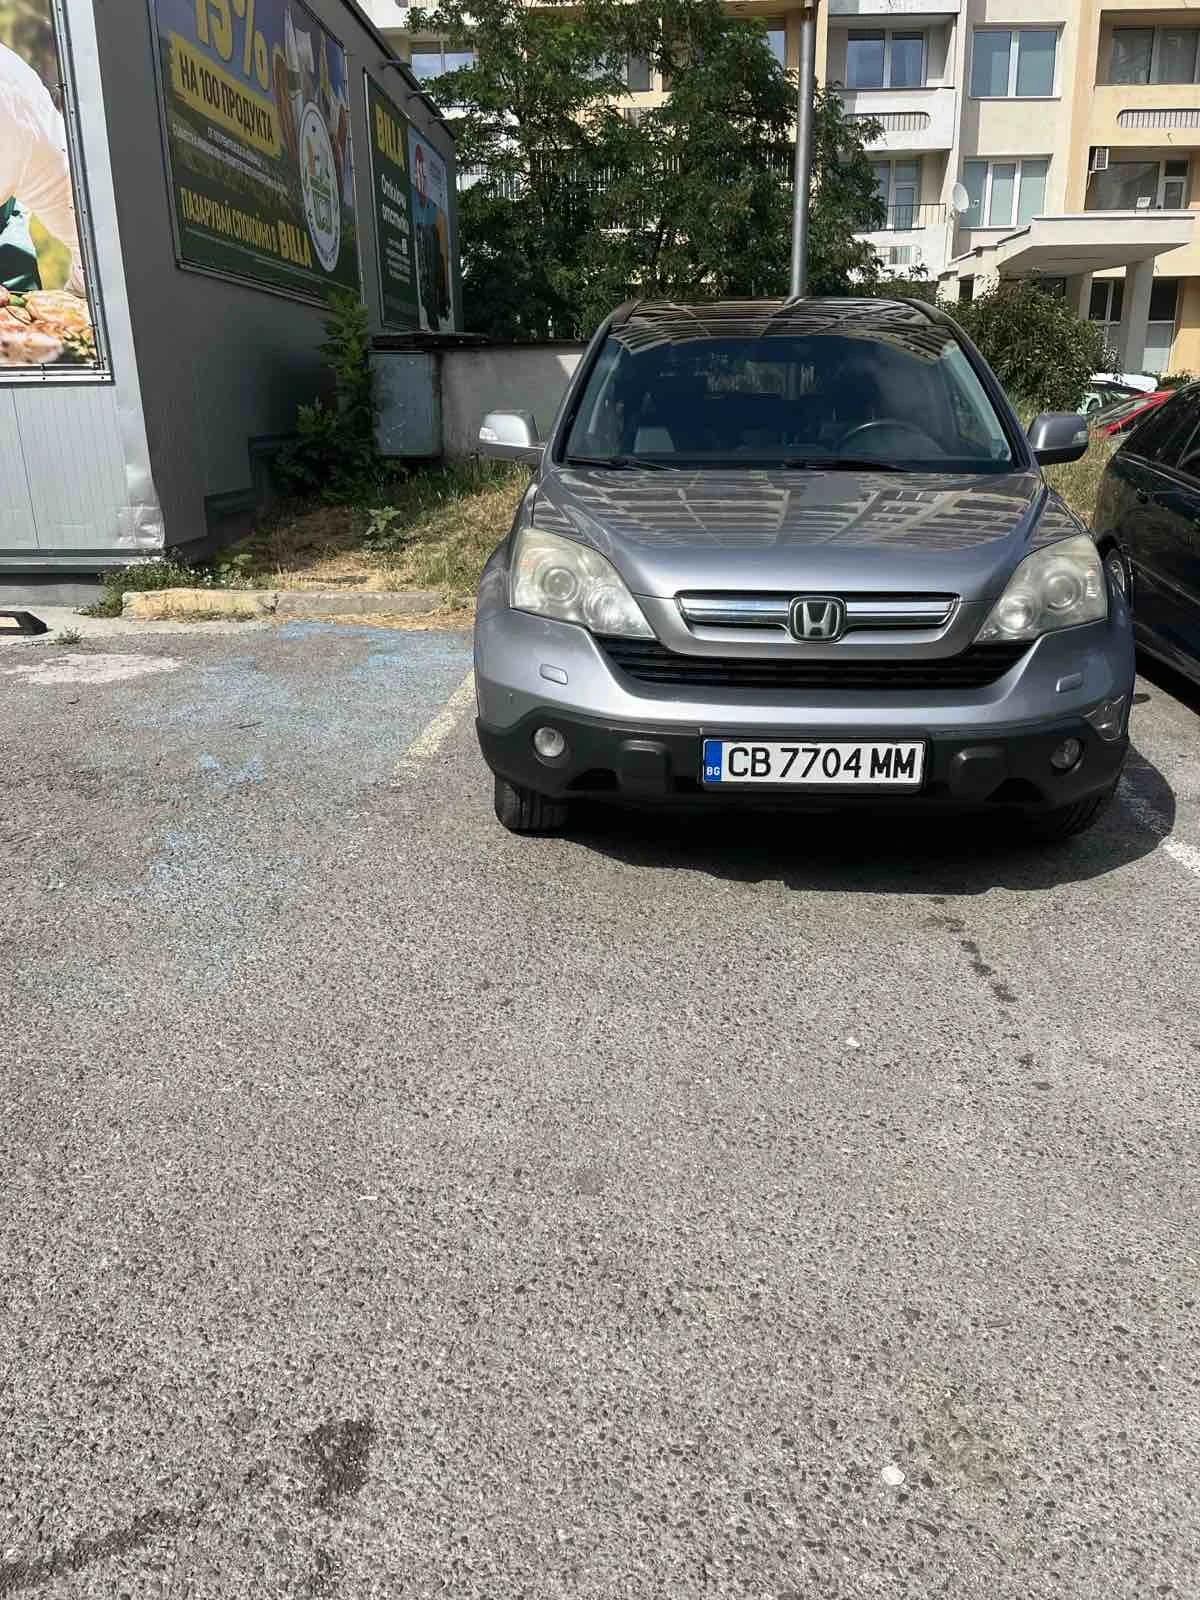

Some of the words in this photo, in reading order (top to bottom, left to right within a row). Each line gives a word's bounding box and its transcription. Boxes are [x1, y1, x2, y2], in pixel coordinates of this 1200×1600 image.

[179, 50, 200, 97] НА
[199, 66, 221, 110] 100
[221, 81, 275, 146] ПРОДУКТА
[375, 103, 406, 171] BILLA
[278, 219, 313, 269] BILLA
[706, 766, 721, 776] BG
[728, 747, 771, 777] CB
[779, 747, 862, 778] 7704
[870, 748, 917, 778] MM
